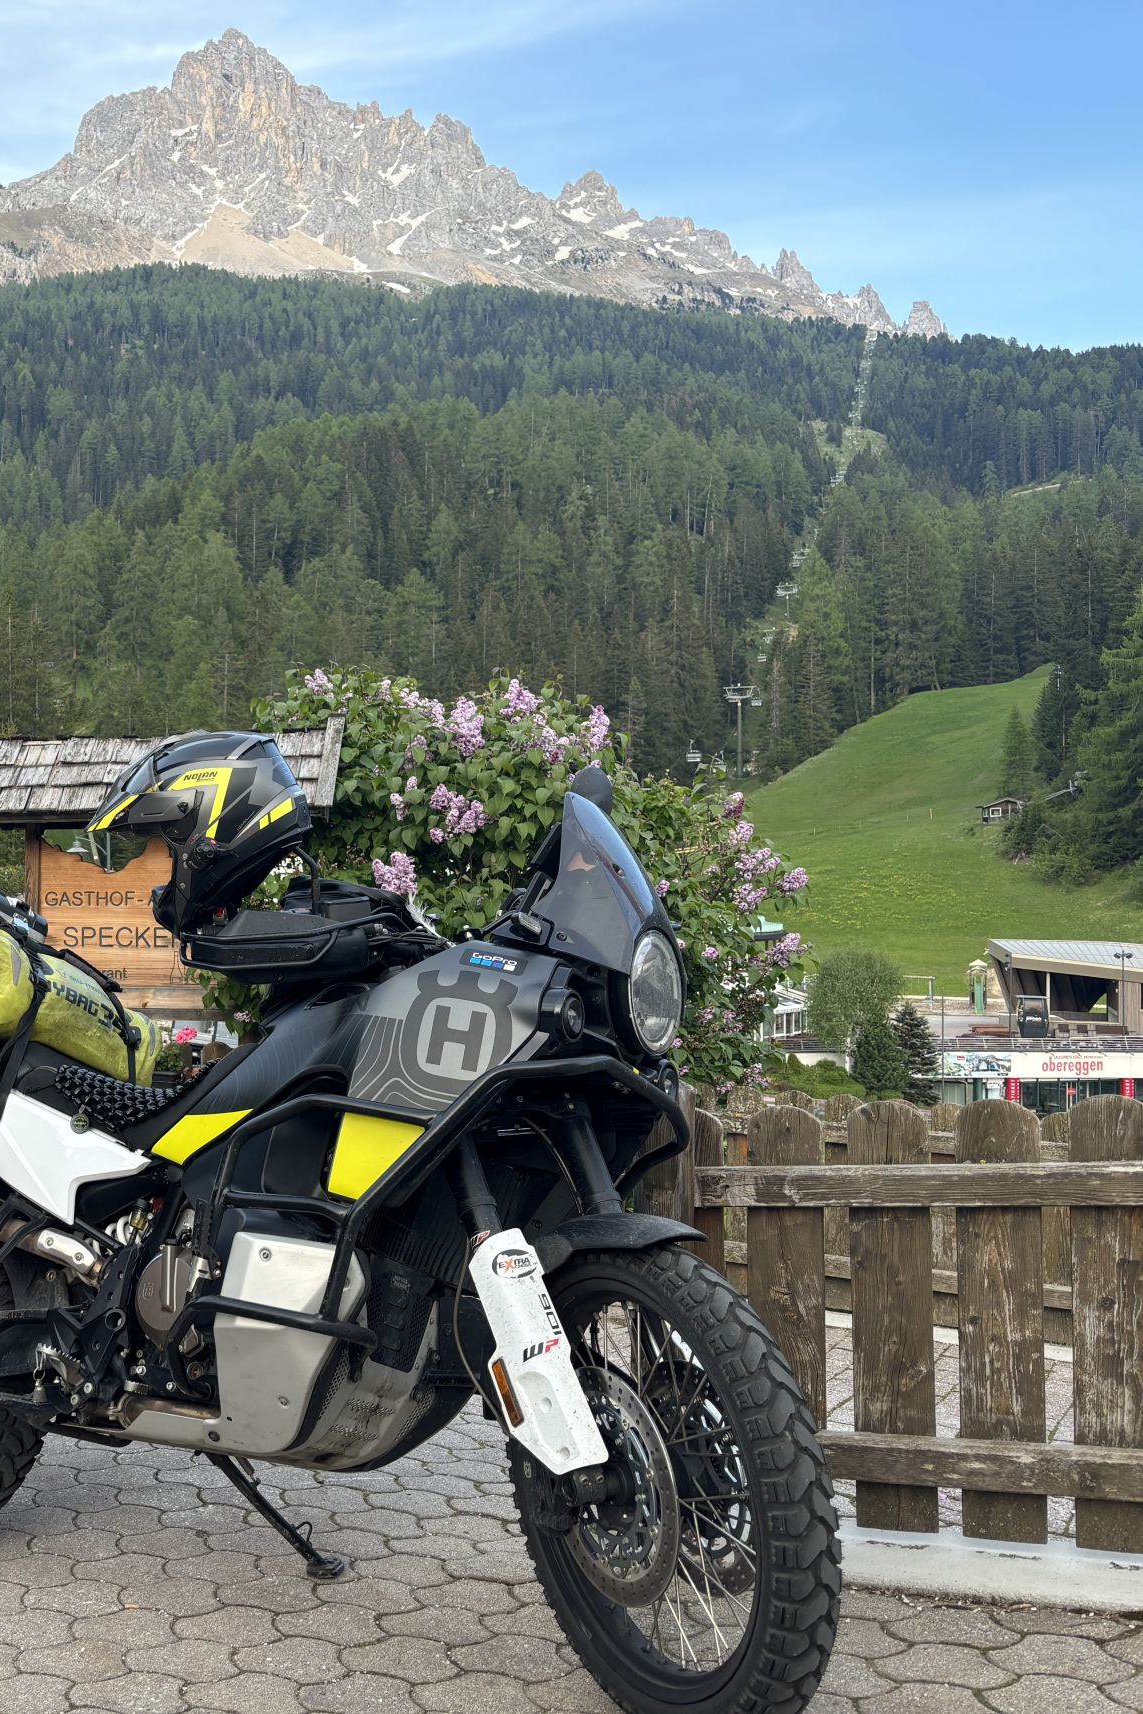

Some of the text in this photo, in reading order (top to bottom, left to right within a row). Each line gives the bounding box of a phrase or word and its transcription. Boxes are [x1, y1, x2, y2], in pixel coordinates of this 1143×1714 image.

[183, 771, 218, 782] NOLAN
[63, 926, 176, 948] SPECKE
[472, 952, 518, 966] GoPro
[1042, 1056, 1104, 1075] obereggen
[538, 1293, 562, 1335] 901
[523, 1338, 559, 1362] WP
